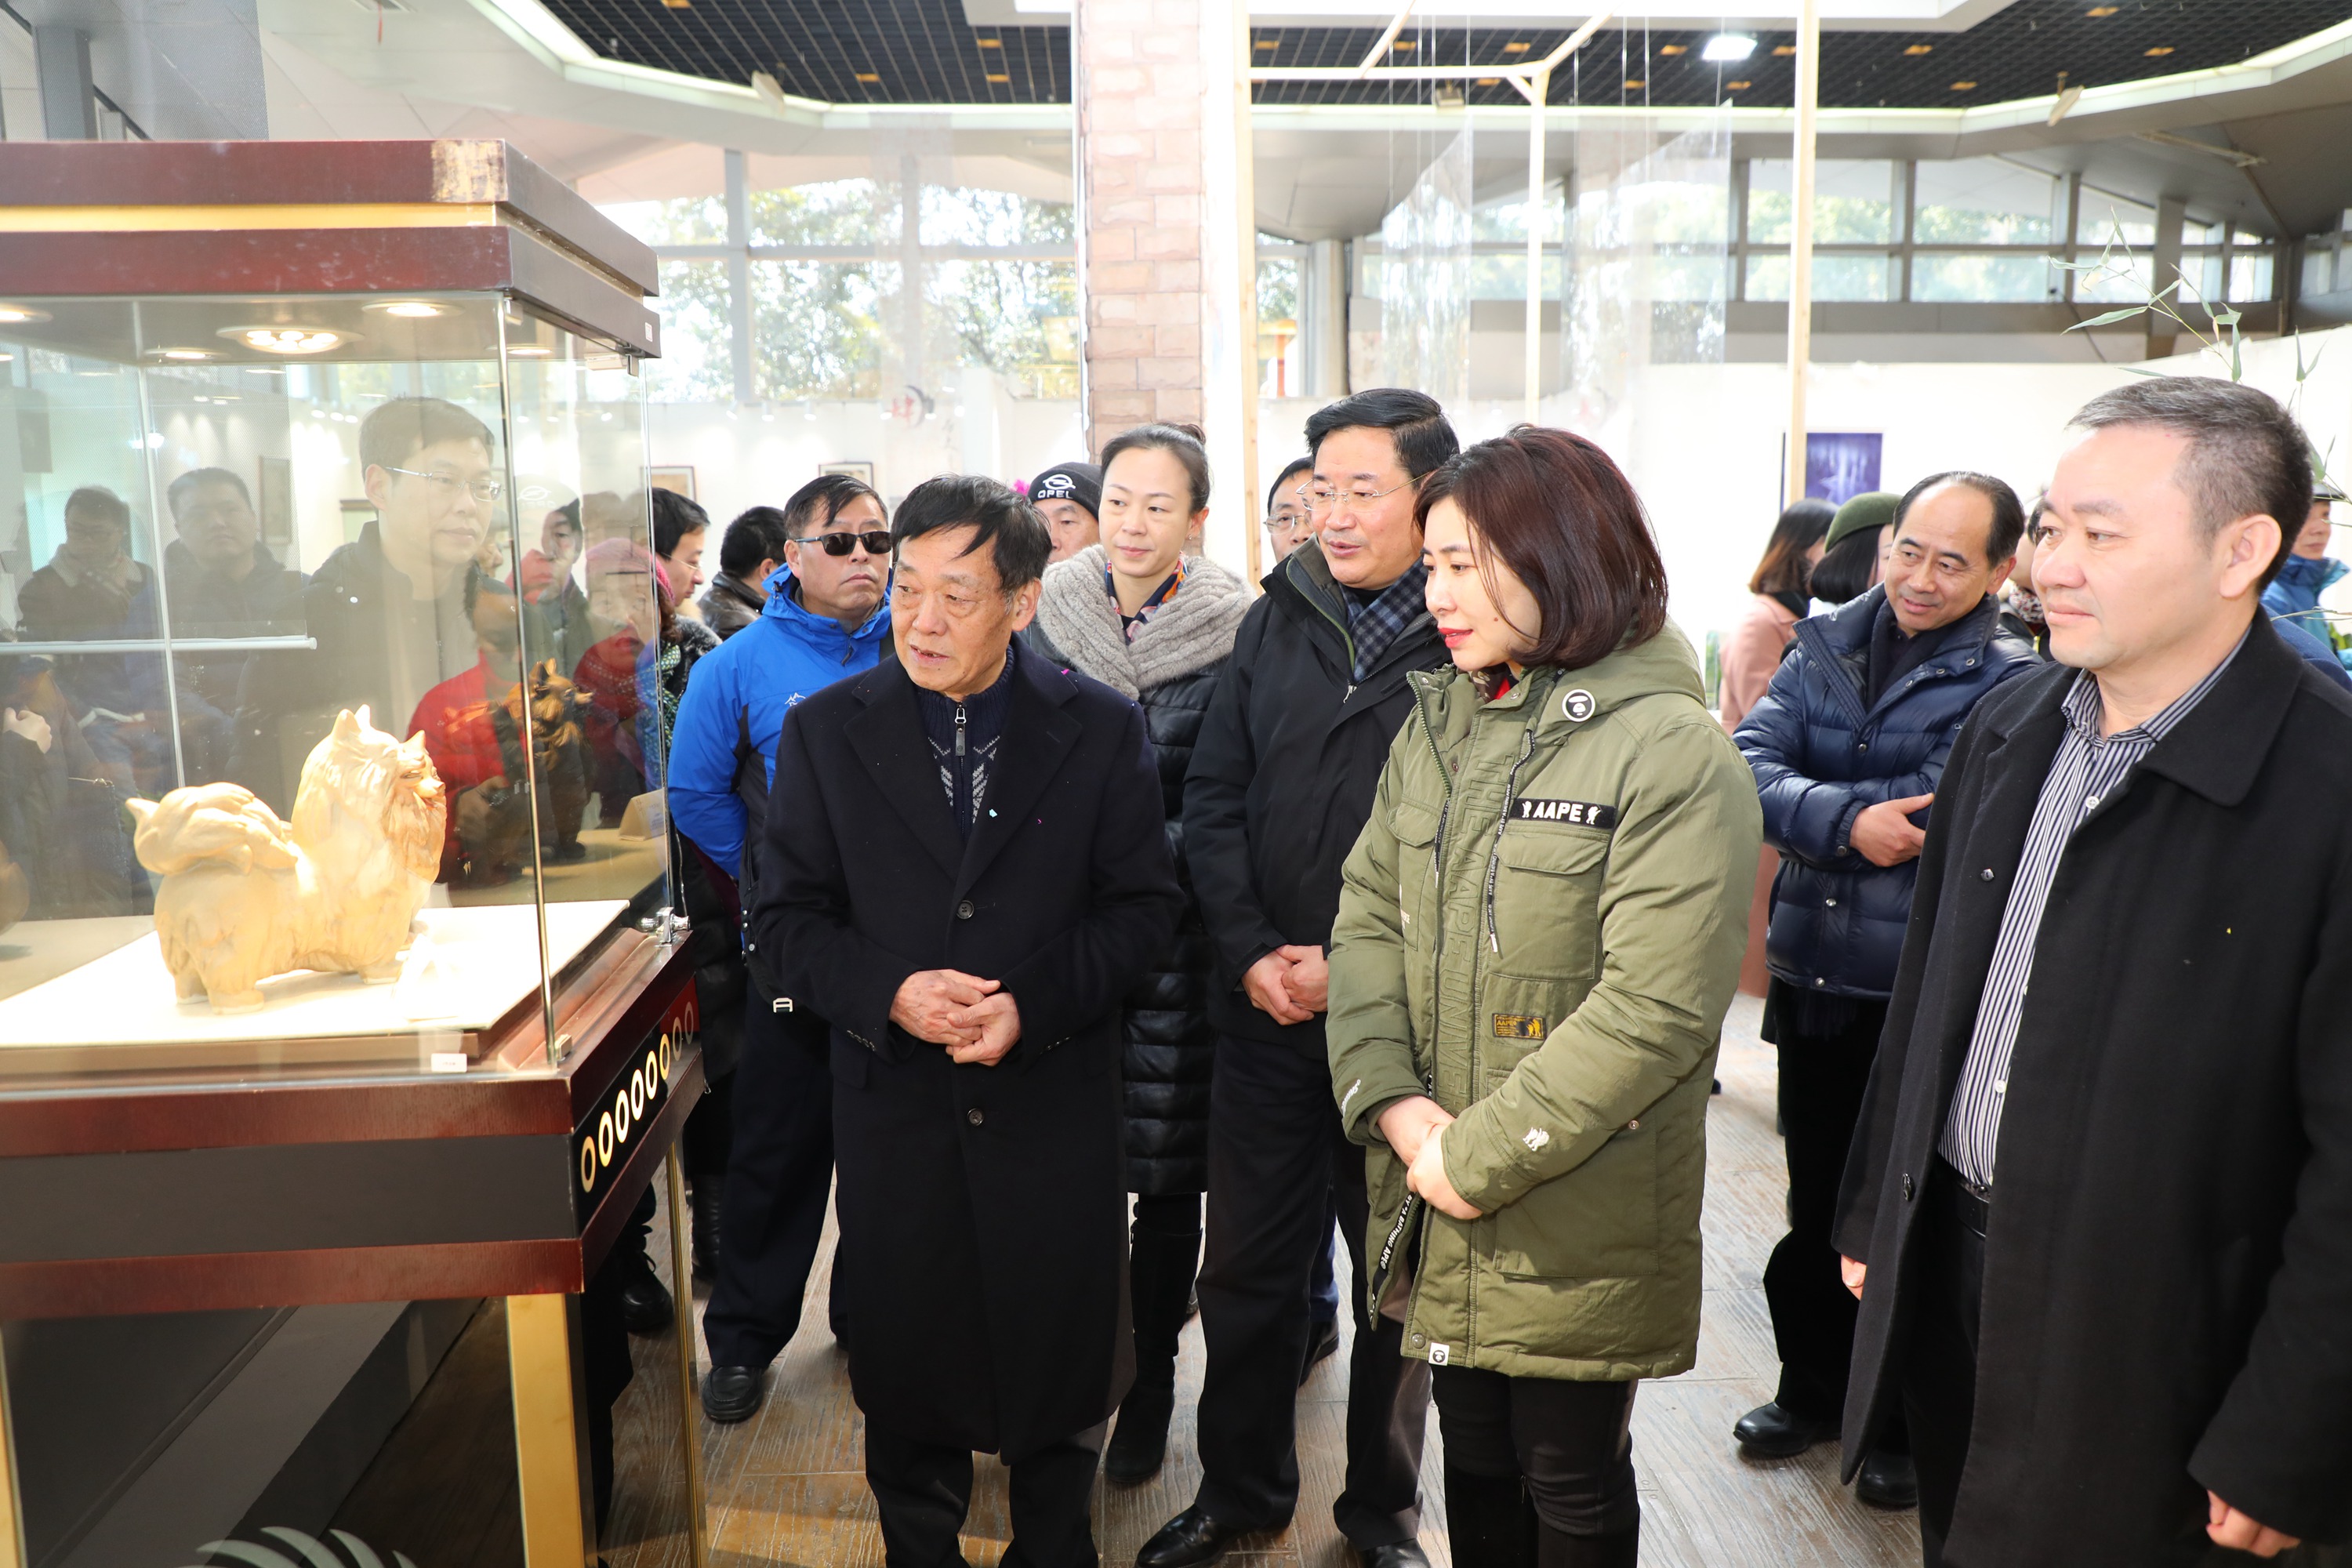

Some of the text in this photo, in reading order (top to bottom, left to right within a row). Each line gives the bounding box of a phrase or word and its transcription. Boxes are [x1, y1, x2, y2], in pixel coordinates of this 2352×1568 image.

[1037, 489, 1074, 499] OPEL
[1461, 754, 1516, 837] THE
[1533, 801, 1584, 822] AAPE
[1442, 847, 1486, 963] AAPE
[1385, 1215, 1406, 1247] BATHING
